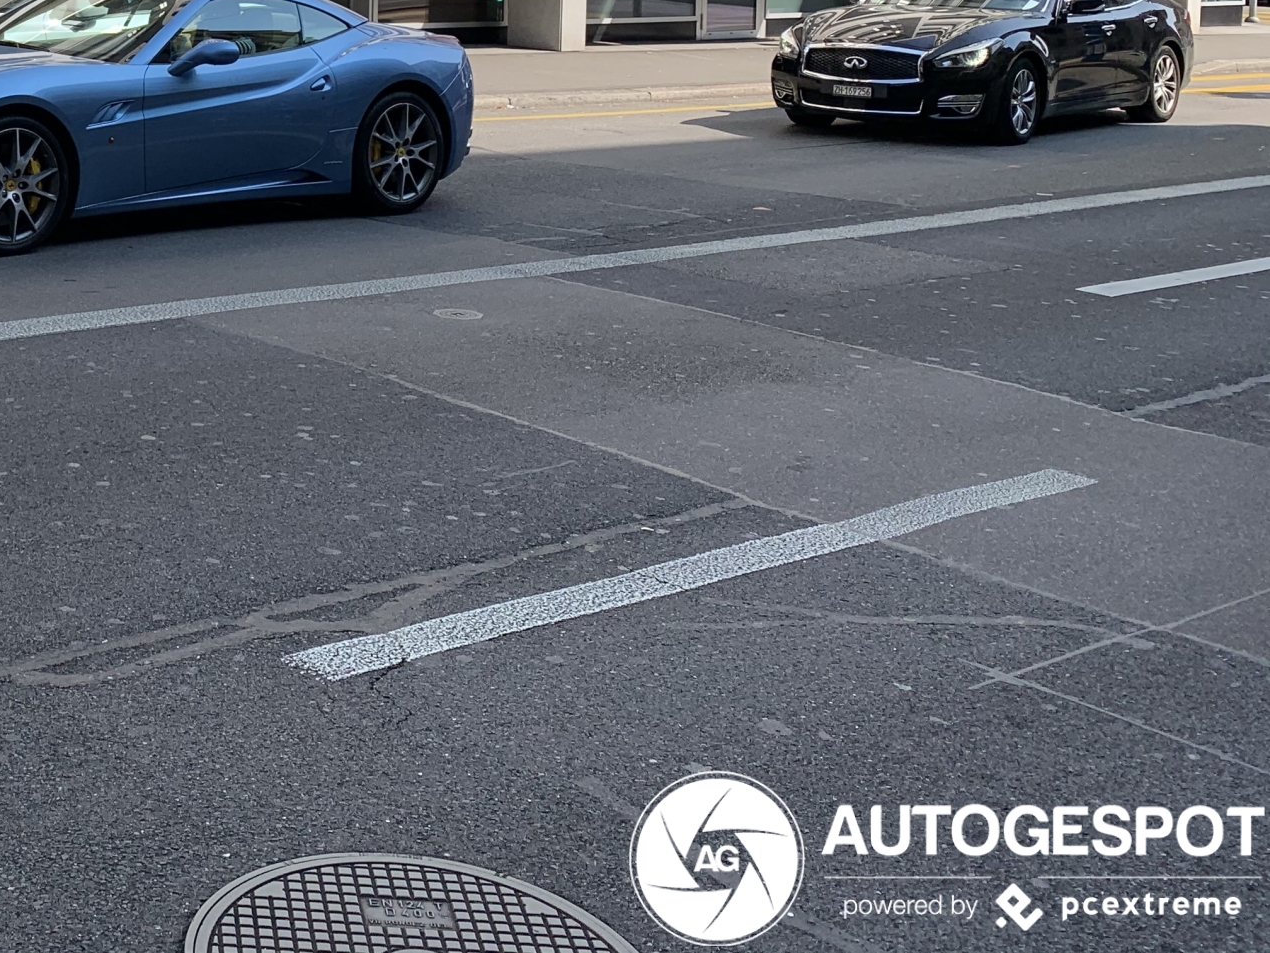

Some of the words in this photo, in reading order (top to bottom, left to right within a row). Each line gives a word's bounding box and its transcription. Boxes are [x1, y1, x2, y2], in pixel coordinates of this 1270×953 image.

[368, 898, 393, 908] EN
[397, 900, 425, 910] 124
[401, 909, 436, 919] 400
